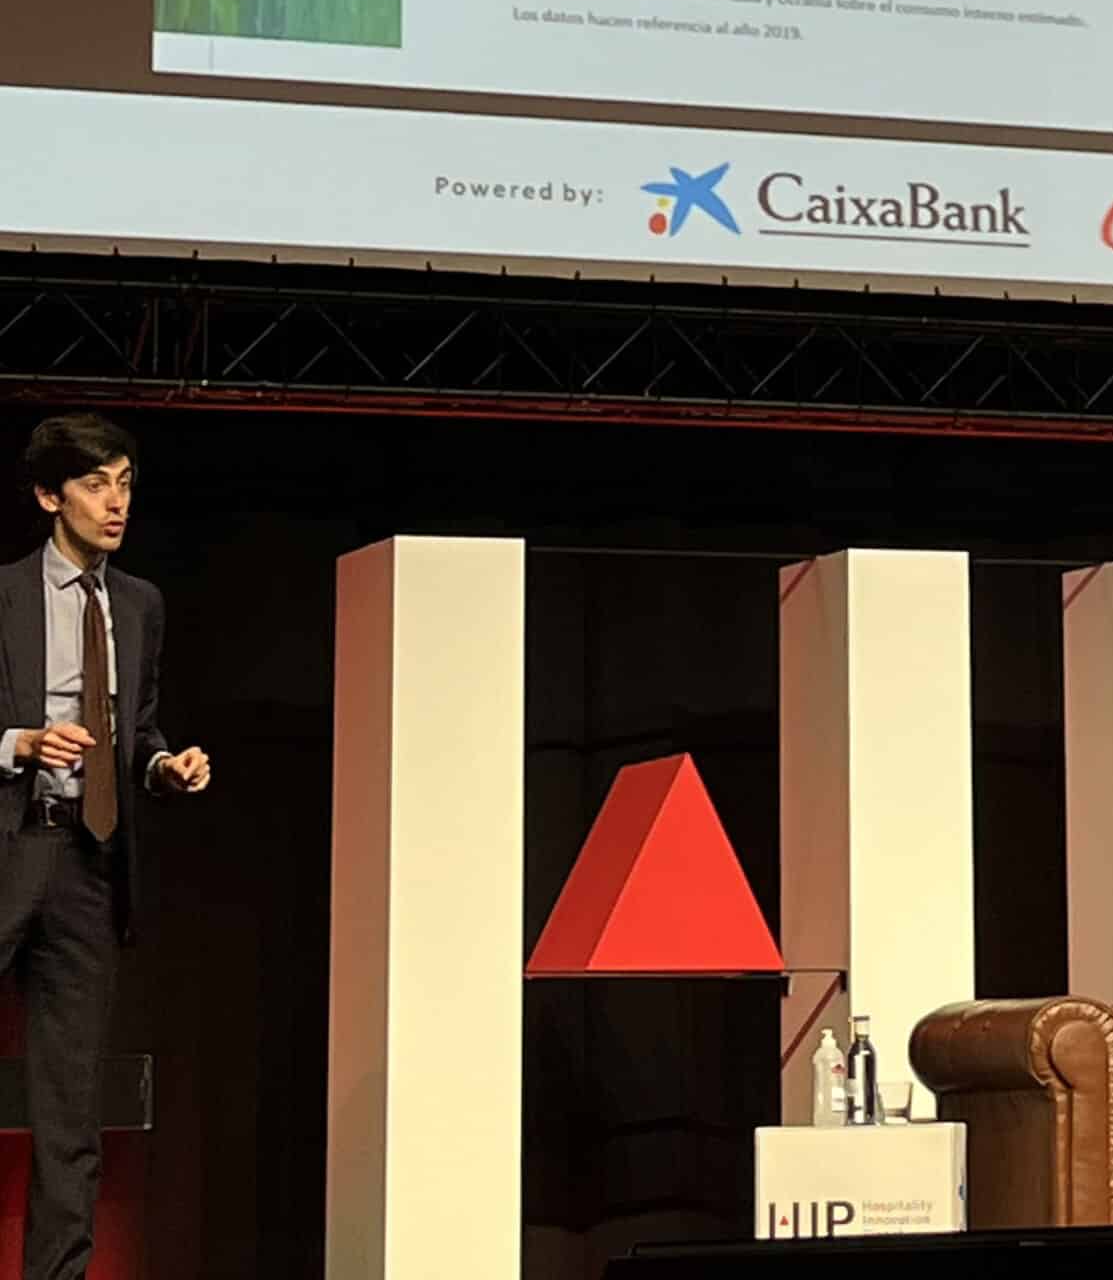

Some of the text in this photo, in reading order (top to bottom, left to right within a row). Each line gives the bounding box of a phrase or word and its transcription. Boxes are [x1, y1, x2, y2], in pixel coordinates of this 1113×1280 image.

[512, 6, 538, 22] Los
[541, 8, 584, 25] datos
[637, 14, 712, 34] referencia
[715, 21, 729, 36] al
[880, 0, 893, 13] el
[895, 1, 960, 19] consumo
[435, 175, 604, 207] Powered by:
[757, 171, 1029, 236] CaixaBank
[861, 1198, 933, 1213] Hospitality
